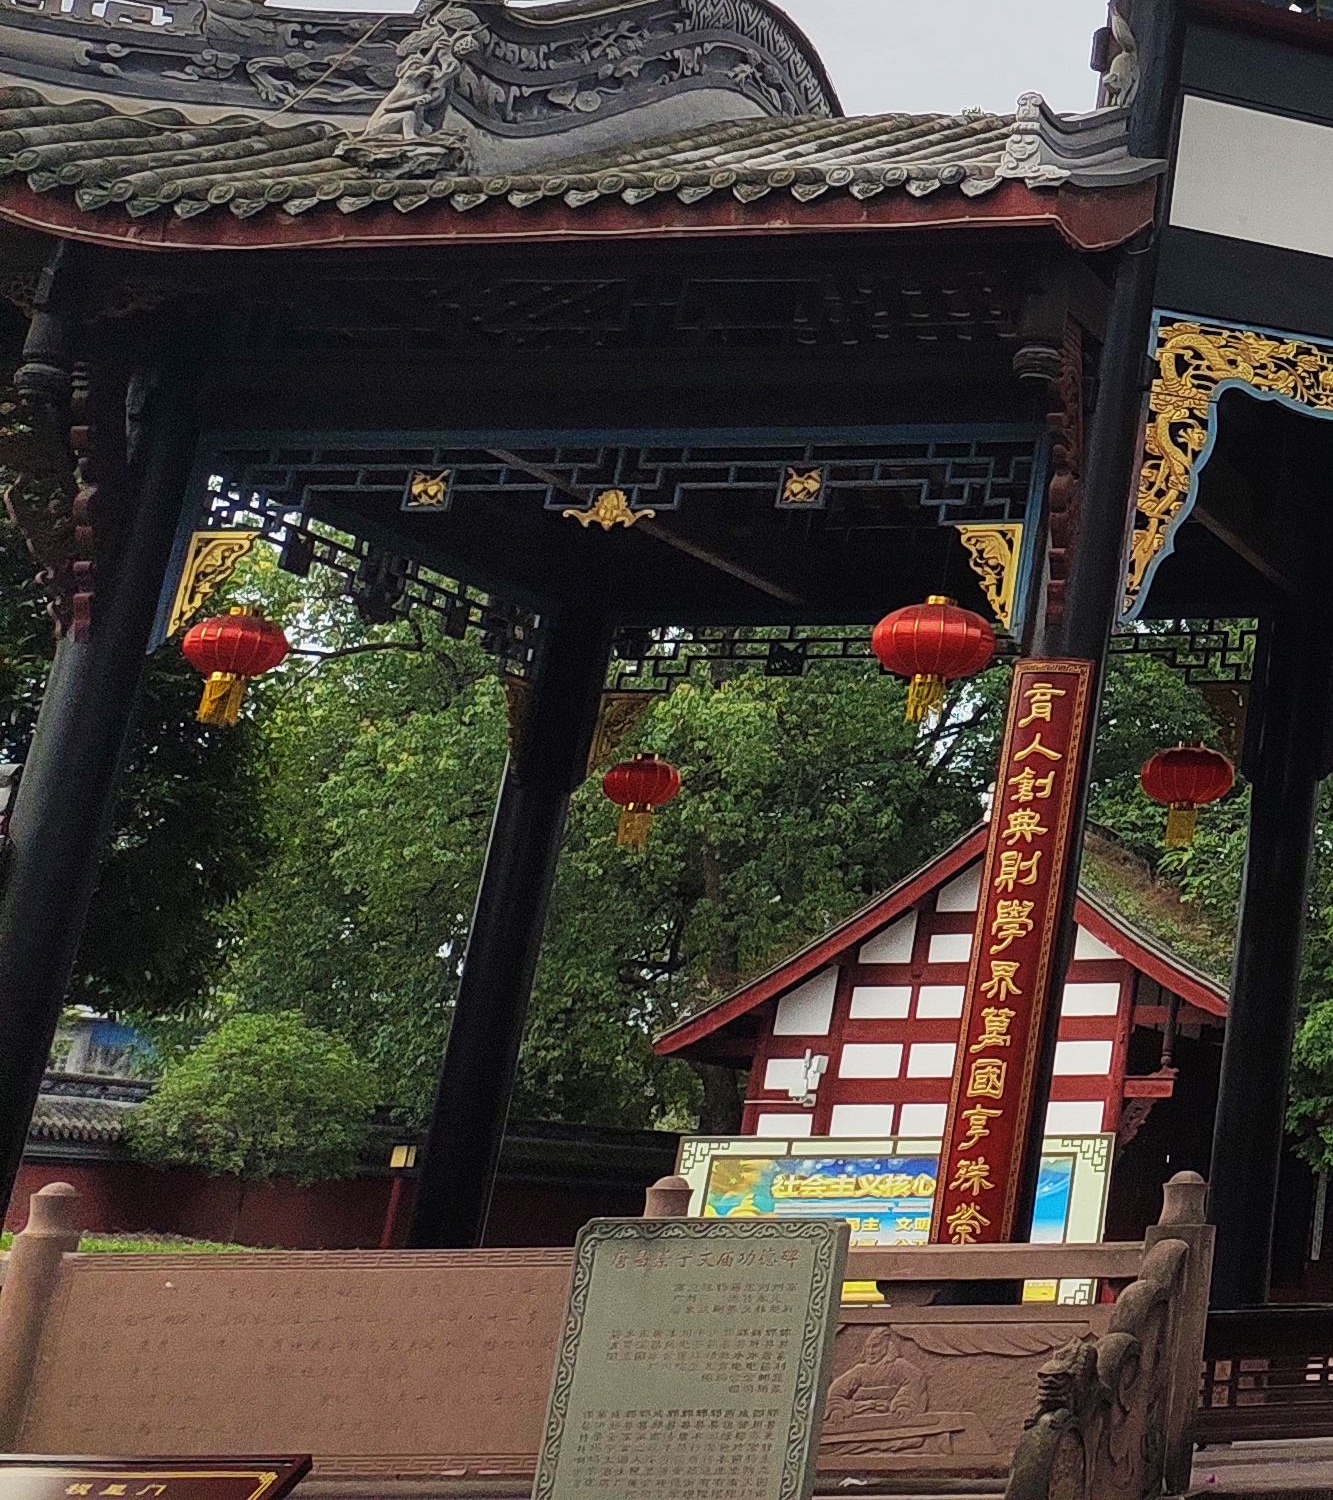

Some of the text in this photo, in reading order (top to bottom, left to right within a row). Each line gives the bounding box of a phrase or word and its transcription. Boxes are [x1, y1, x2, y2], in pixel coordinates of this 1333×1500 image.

[772, 1173, 936, 1198] 社会主义核心
